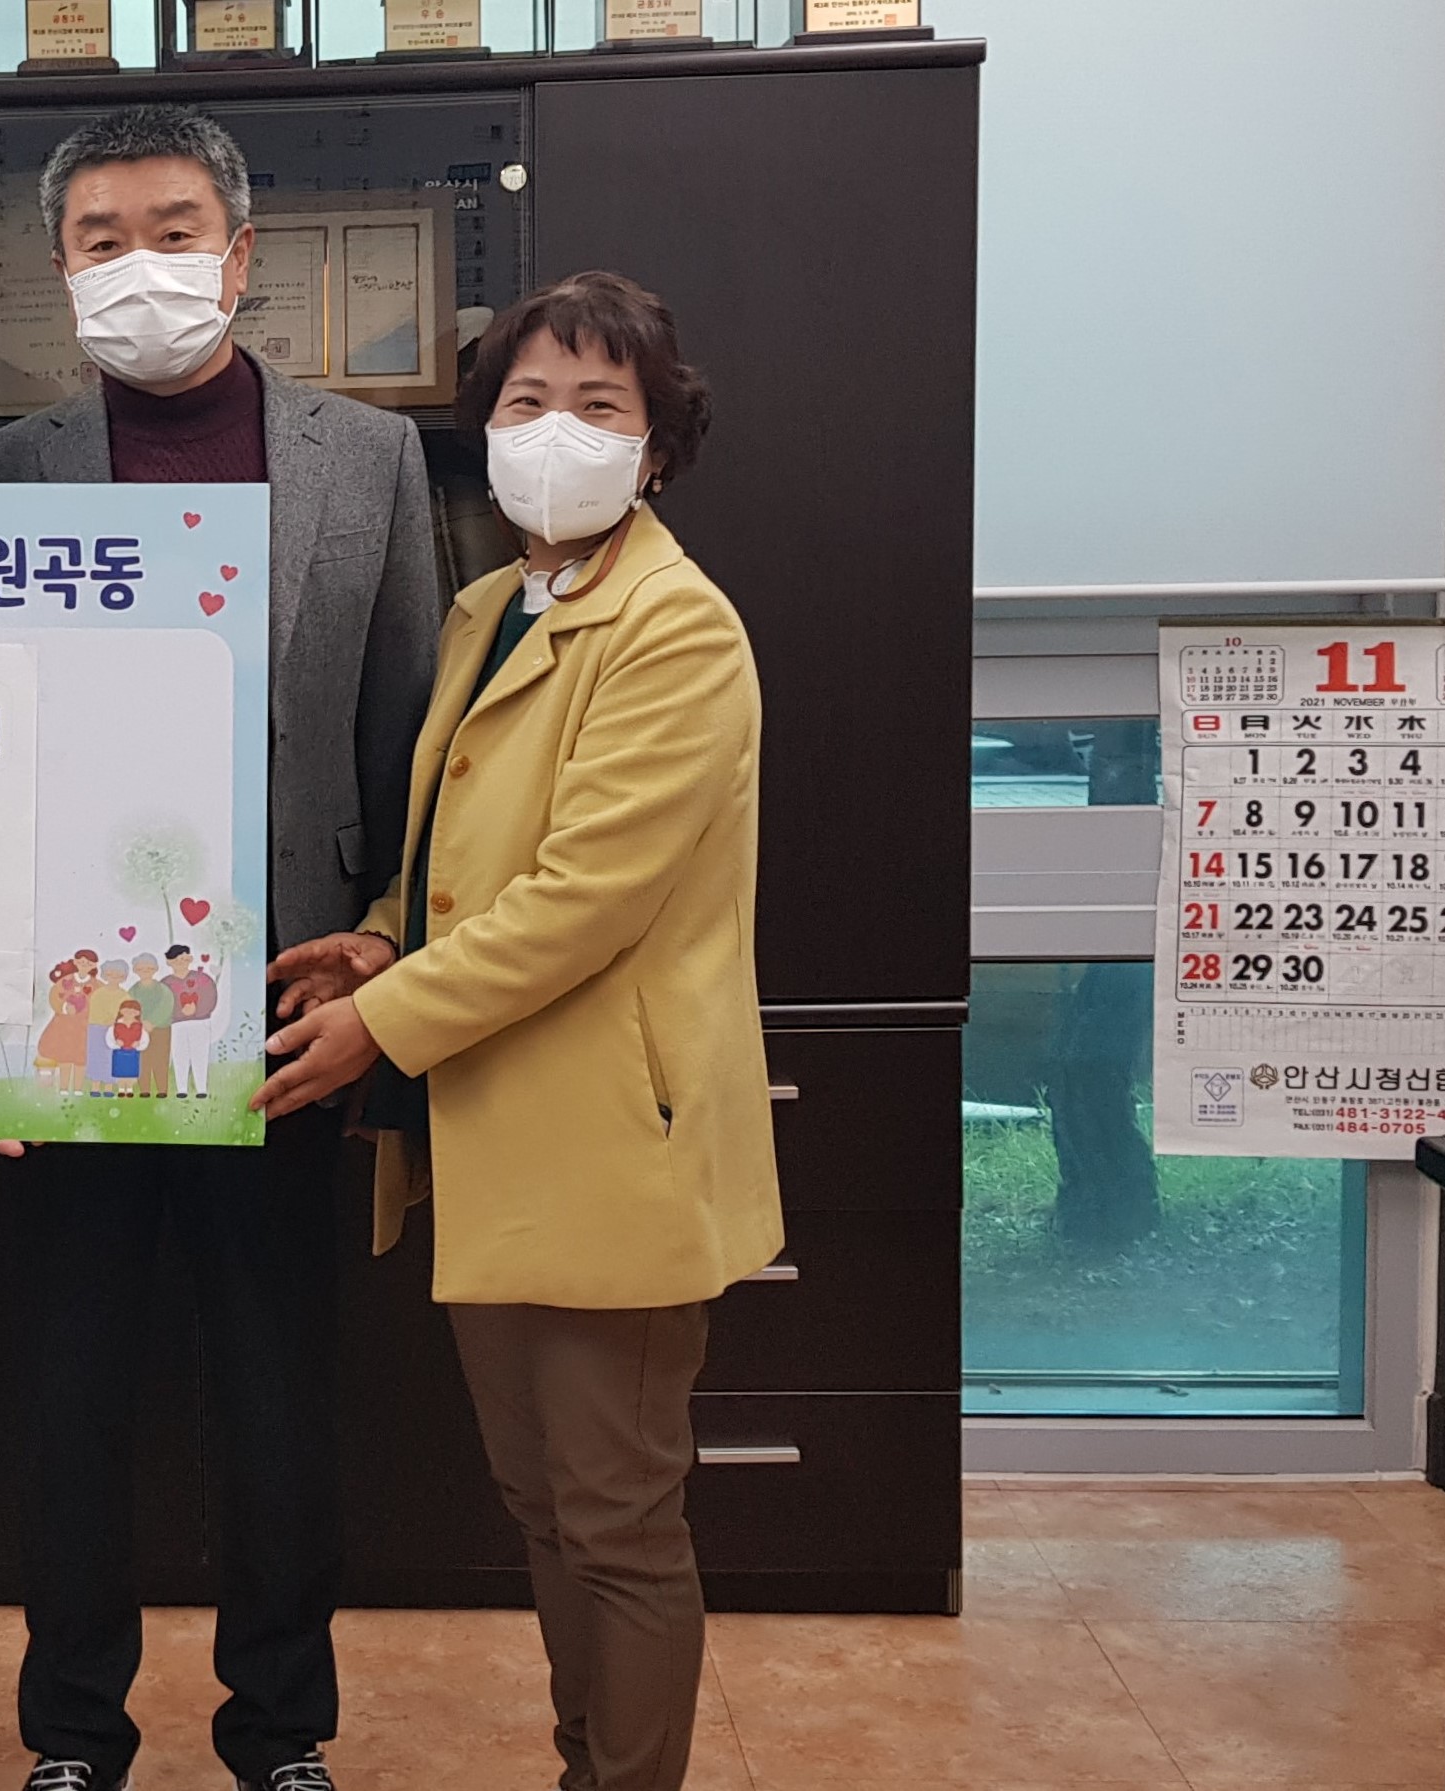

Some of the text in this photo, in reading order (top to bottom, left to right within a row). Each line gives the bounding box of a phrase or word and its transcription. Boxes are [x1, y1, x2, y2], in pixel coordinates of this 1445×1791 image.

[1224, 637, 1242, 647] 10
[1316, 642, 1405, 692] 11
[1300, 698, 1325, 706] 2021
[1334, 698, 1385, 706] NOVEMBER
[1193, 715, 1426, 731] 日 月 火 水 木
[1249, 748, 1421, 776] 1 2 3 4
[1198, 800, 1424, 828] 7 8 9 10 11
[1190, 853, 1429, 881] 14 15 16 17 18
[1184, 903, 1218, 929] 21
[1234, 903, 1273, 930] 22
[1284, 904, 1323, 931] 23
[1336, 904, 1377, 931] 24
[1388, 906, 1428, 933] 25
[1182, 954, 1323, 983] 28 29 30
[1336, 1122, 1425, 1134] 484-0705
